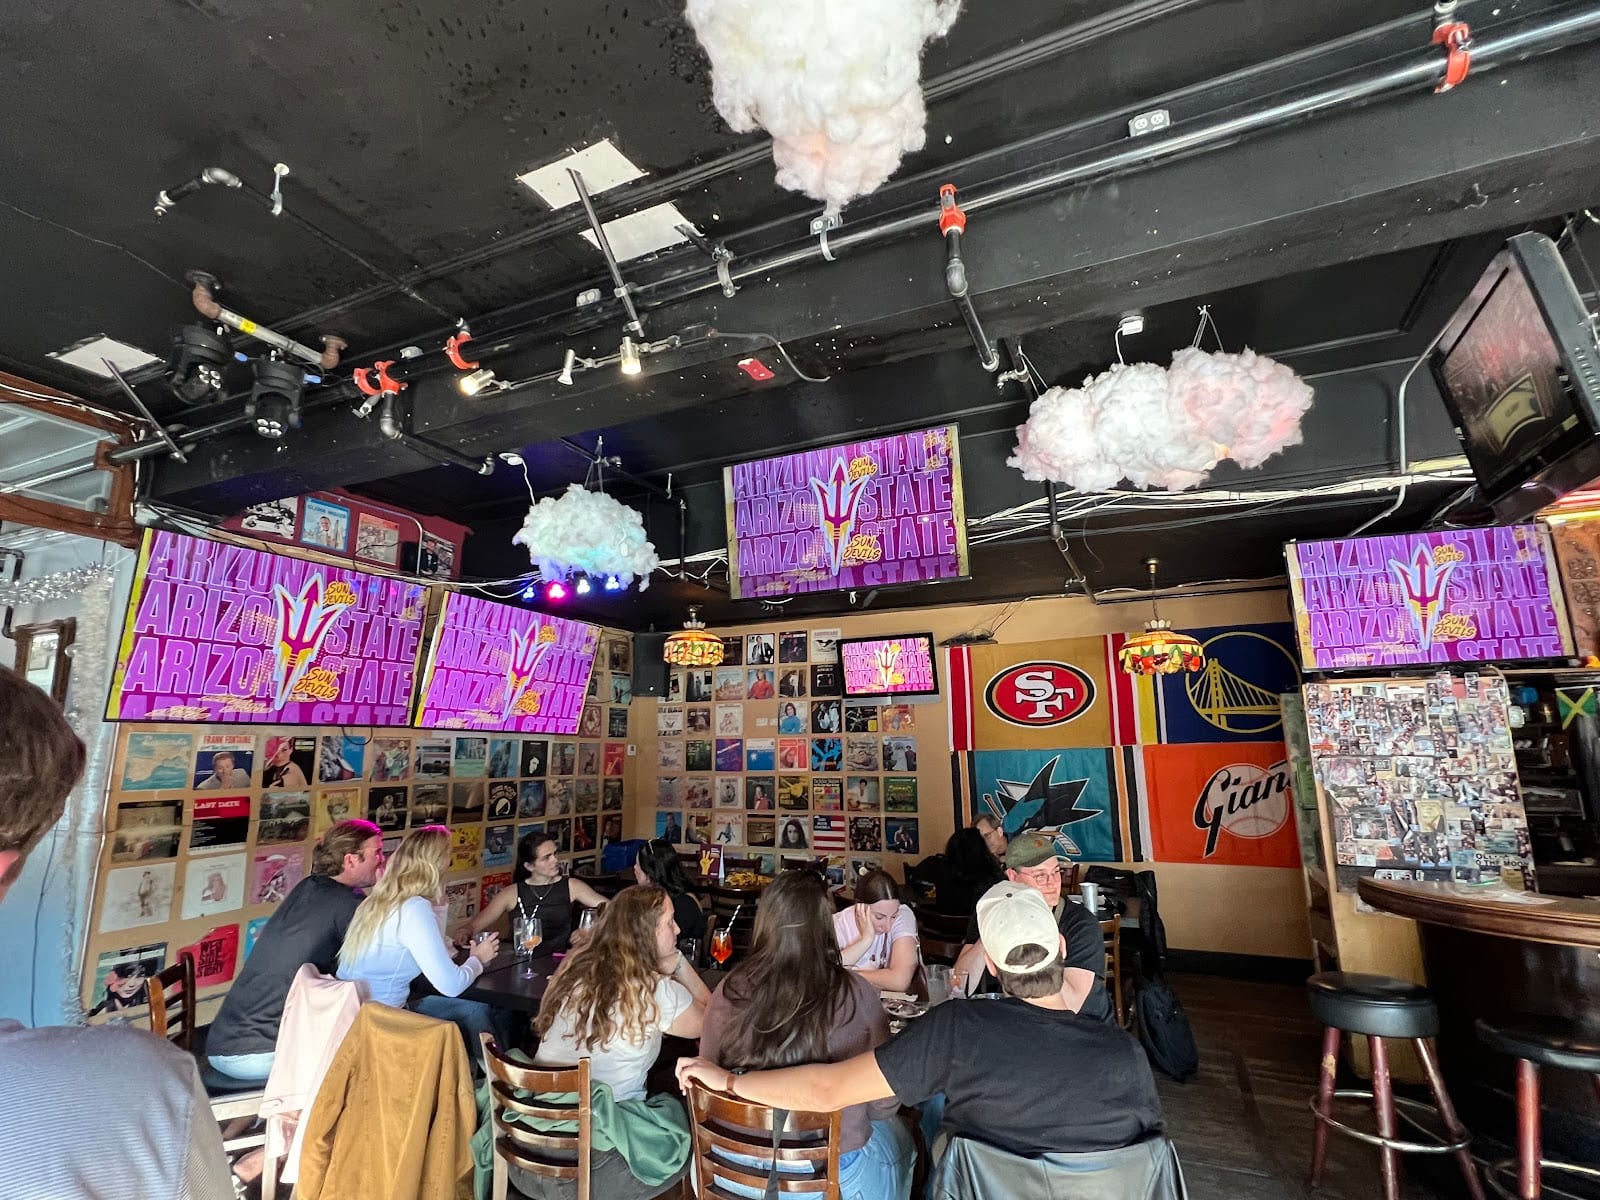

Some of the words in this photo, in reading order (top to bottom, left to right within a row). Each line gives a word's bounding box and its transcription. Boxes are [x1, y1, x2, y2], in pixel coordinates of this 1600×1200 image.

[859, 468, 952, 521] STATE
[738, 529, 832, 578] ARIZON
[843, 547, 881, 560] DEVILS
[851, 536, 876, 547] SUN
[1447, 560, 1549, 602] STATE
[1311, 607, 1419, 648] ARIZON
[1433, 624, 1475, 637] DEVILS
[1441, 615, 1468, 625] SUN
[325, 611, 420, 662] STATE
[121, 637, 278, 698] ARIZON
[306, 668, 337, 684] SUN
[293, 677, 339, 699] DEVILS
